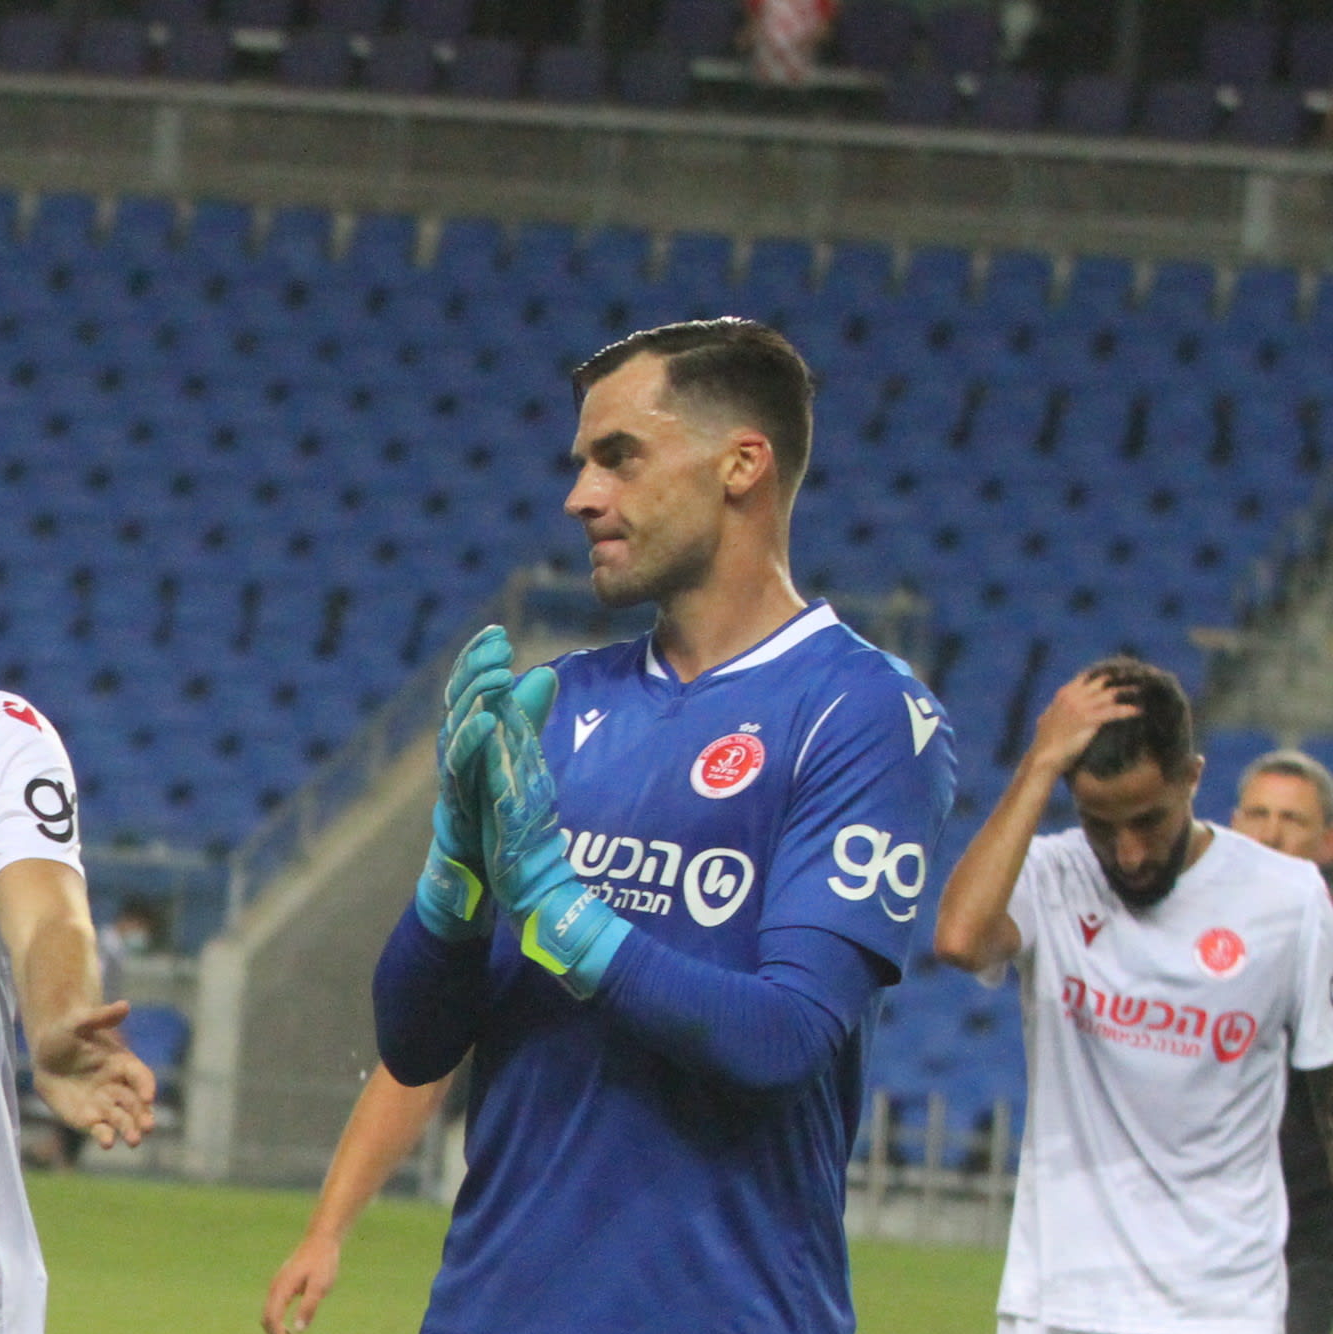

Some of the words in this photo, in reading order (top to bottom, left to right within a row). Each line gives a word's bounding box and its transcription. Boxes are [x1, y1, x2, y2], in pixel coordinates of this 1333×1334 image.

[25, 778, 76, 843] g
[828, 824, 925, 901] go
[614, 888, 672, 915] חברה
[1062, 976, 1208, 1038] הכשרה
